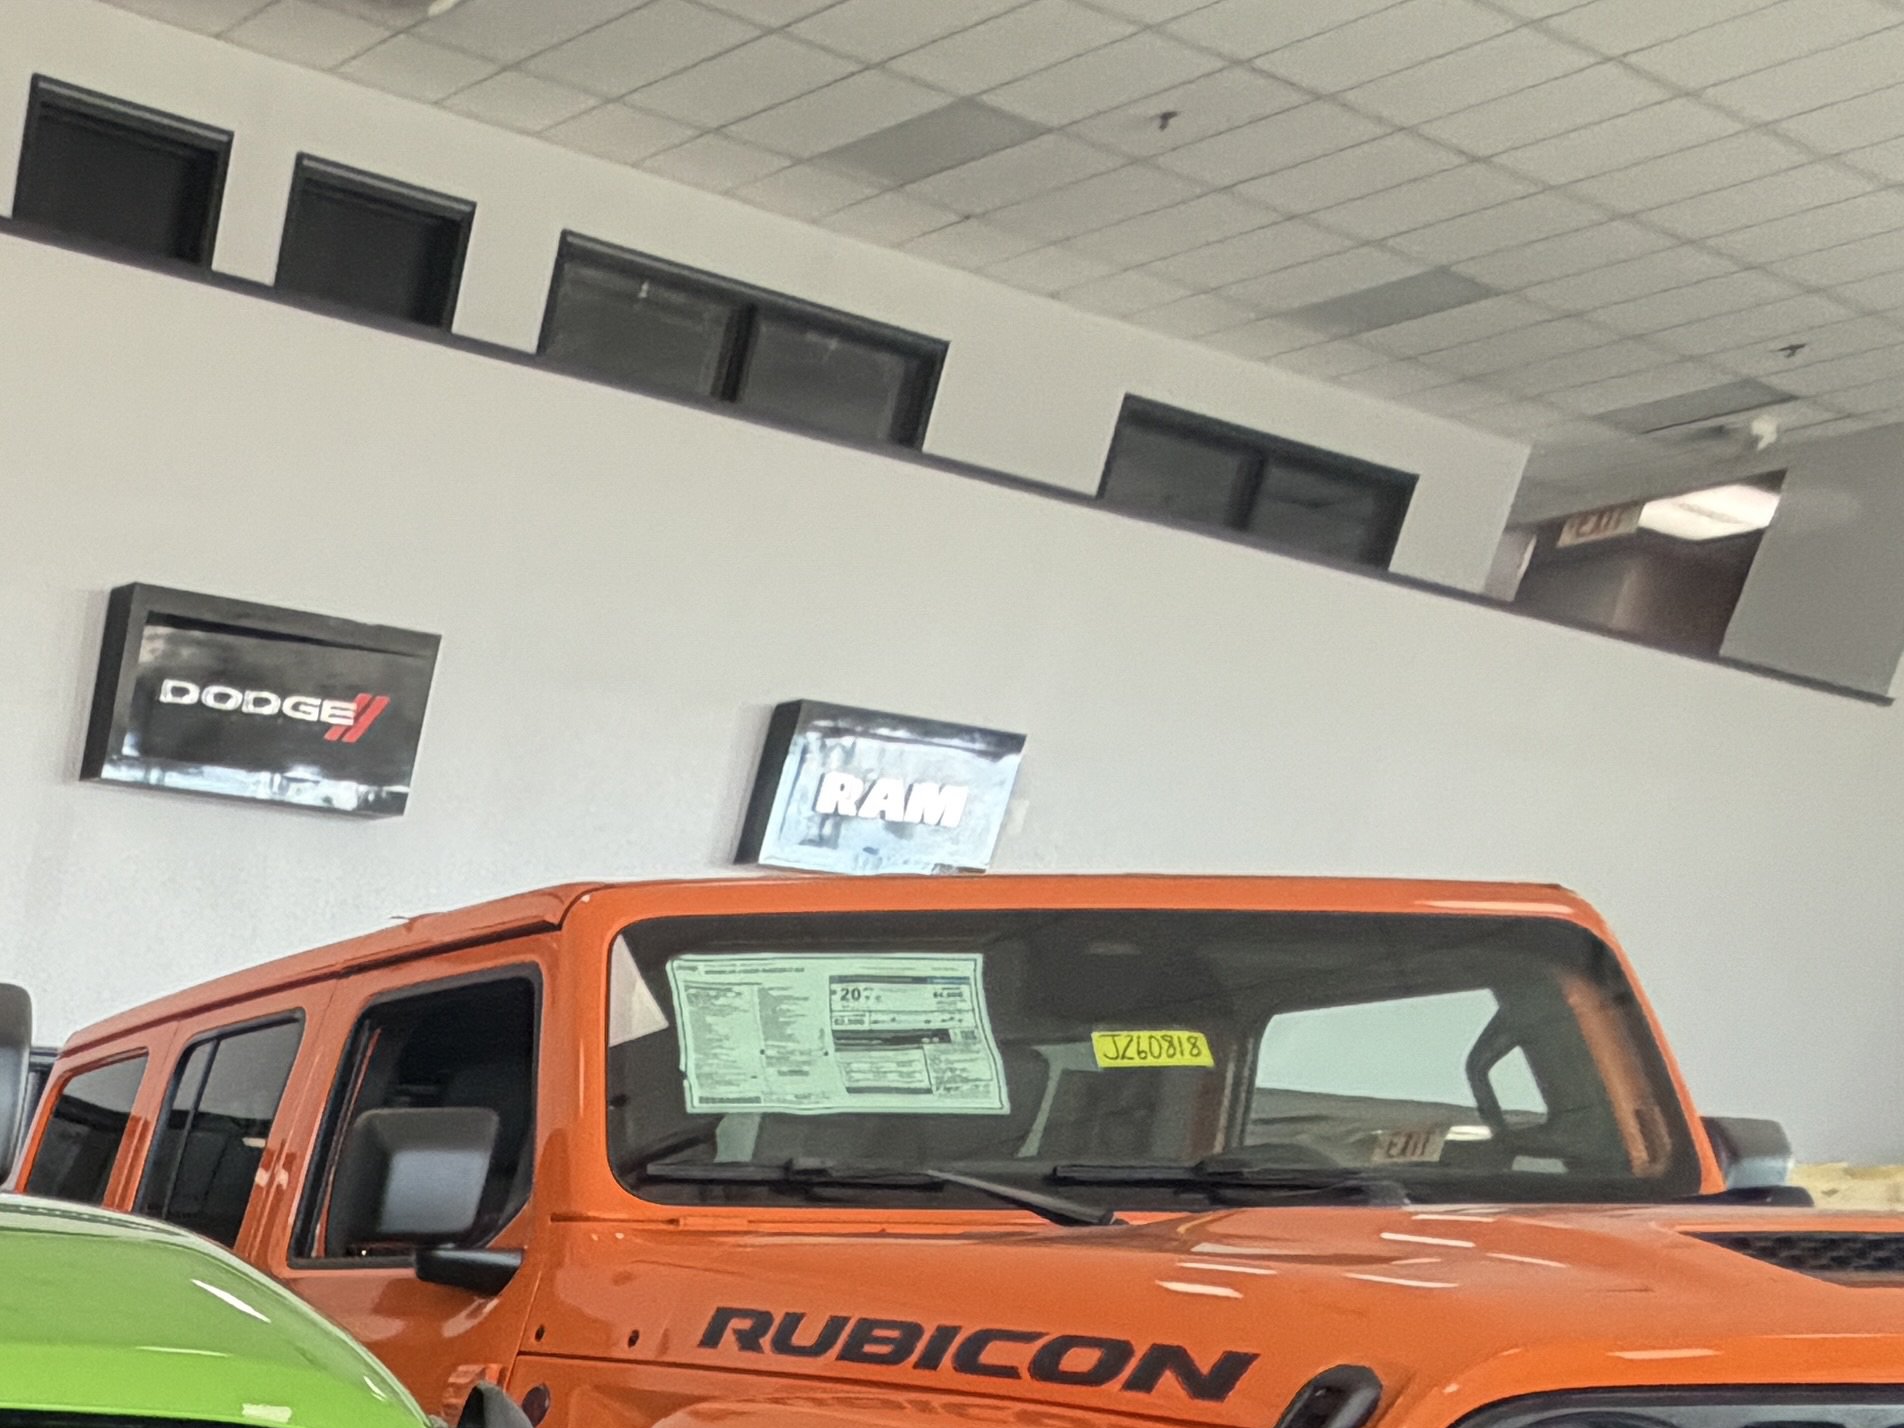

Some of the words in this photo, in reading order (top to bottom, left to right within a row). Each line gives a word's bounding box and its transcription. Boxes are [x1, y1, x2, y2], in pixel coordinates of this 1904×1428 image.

[159, 678, 358, 726] DODGE
[813, 770, 969, 829] RAM
[840, 987, 861, 1002] 20
[696, 1305, 1262, 1403] RUBICON
